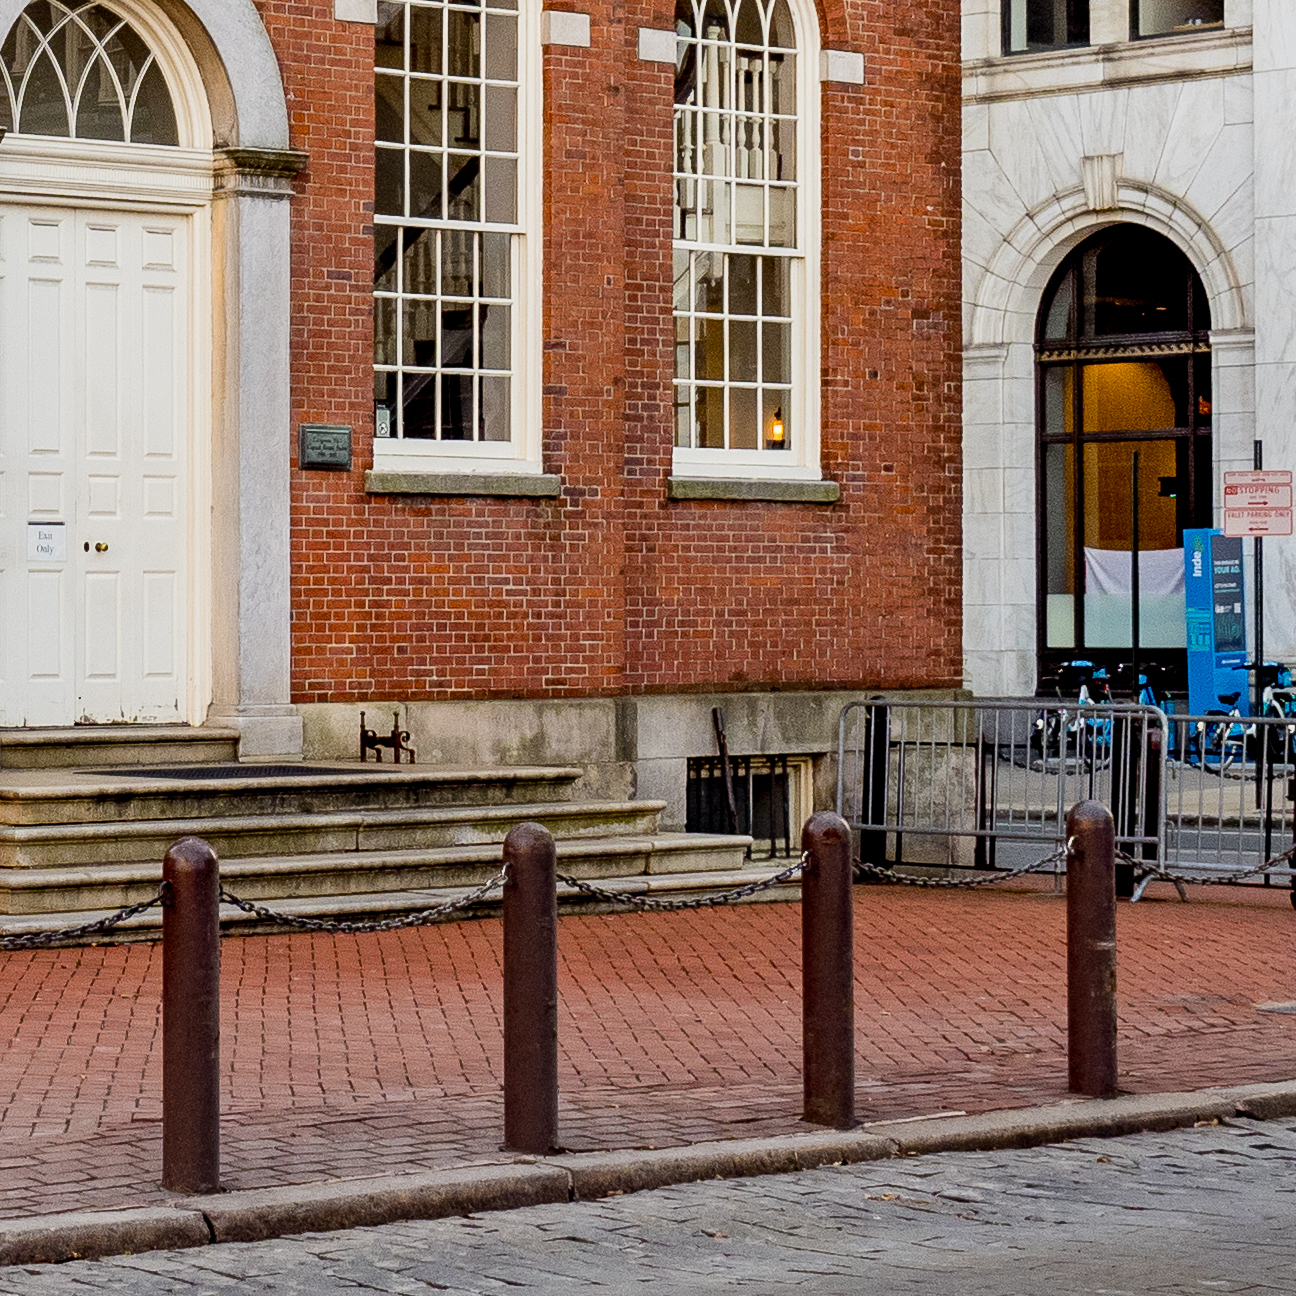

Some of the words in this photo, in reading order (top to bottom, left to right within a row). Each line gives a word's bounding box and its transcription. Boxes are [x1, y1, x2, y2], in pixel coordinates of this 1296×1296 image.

[1238, 486, 1280, 494] STOPPING
[38, 531, 52, 540] Exit
[37, 544, 53, 555] Only
